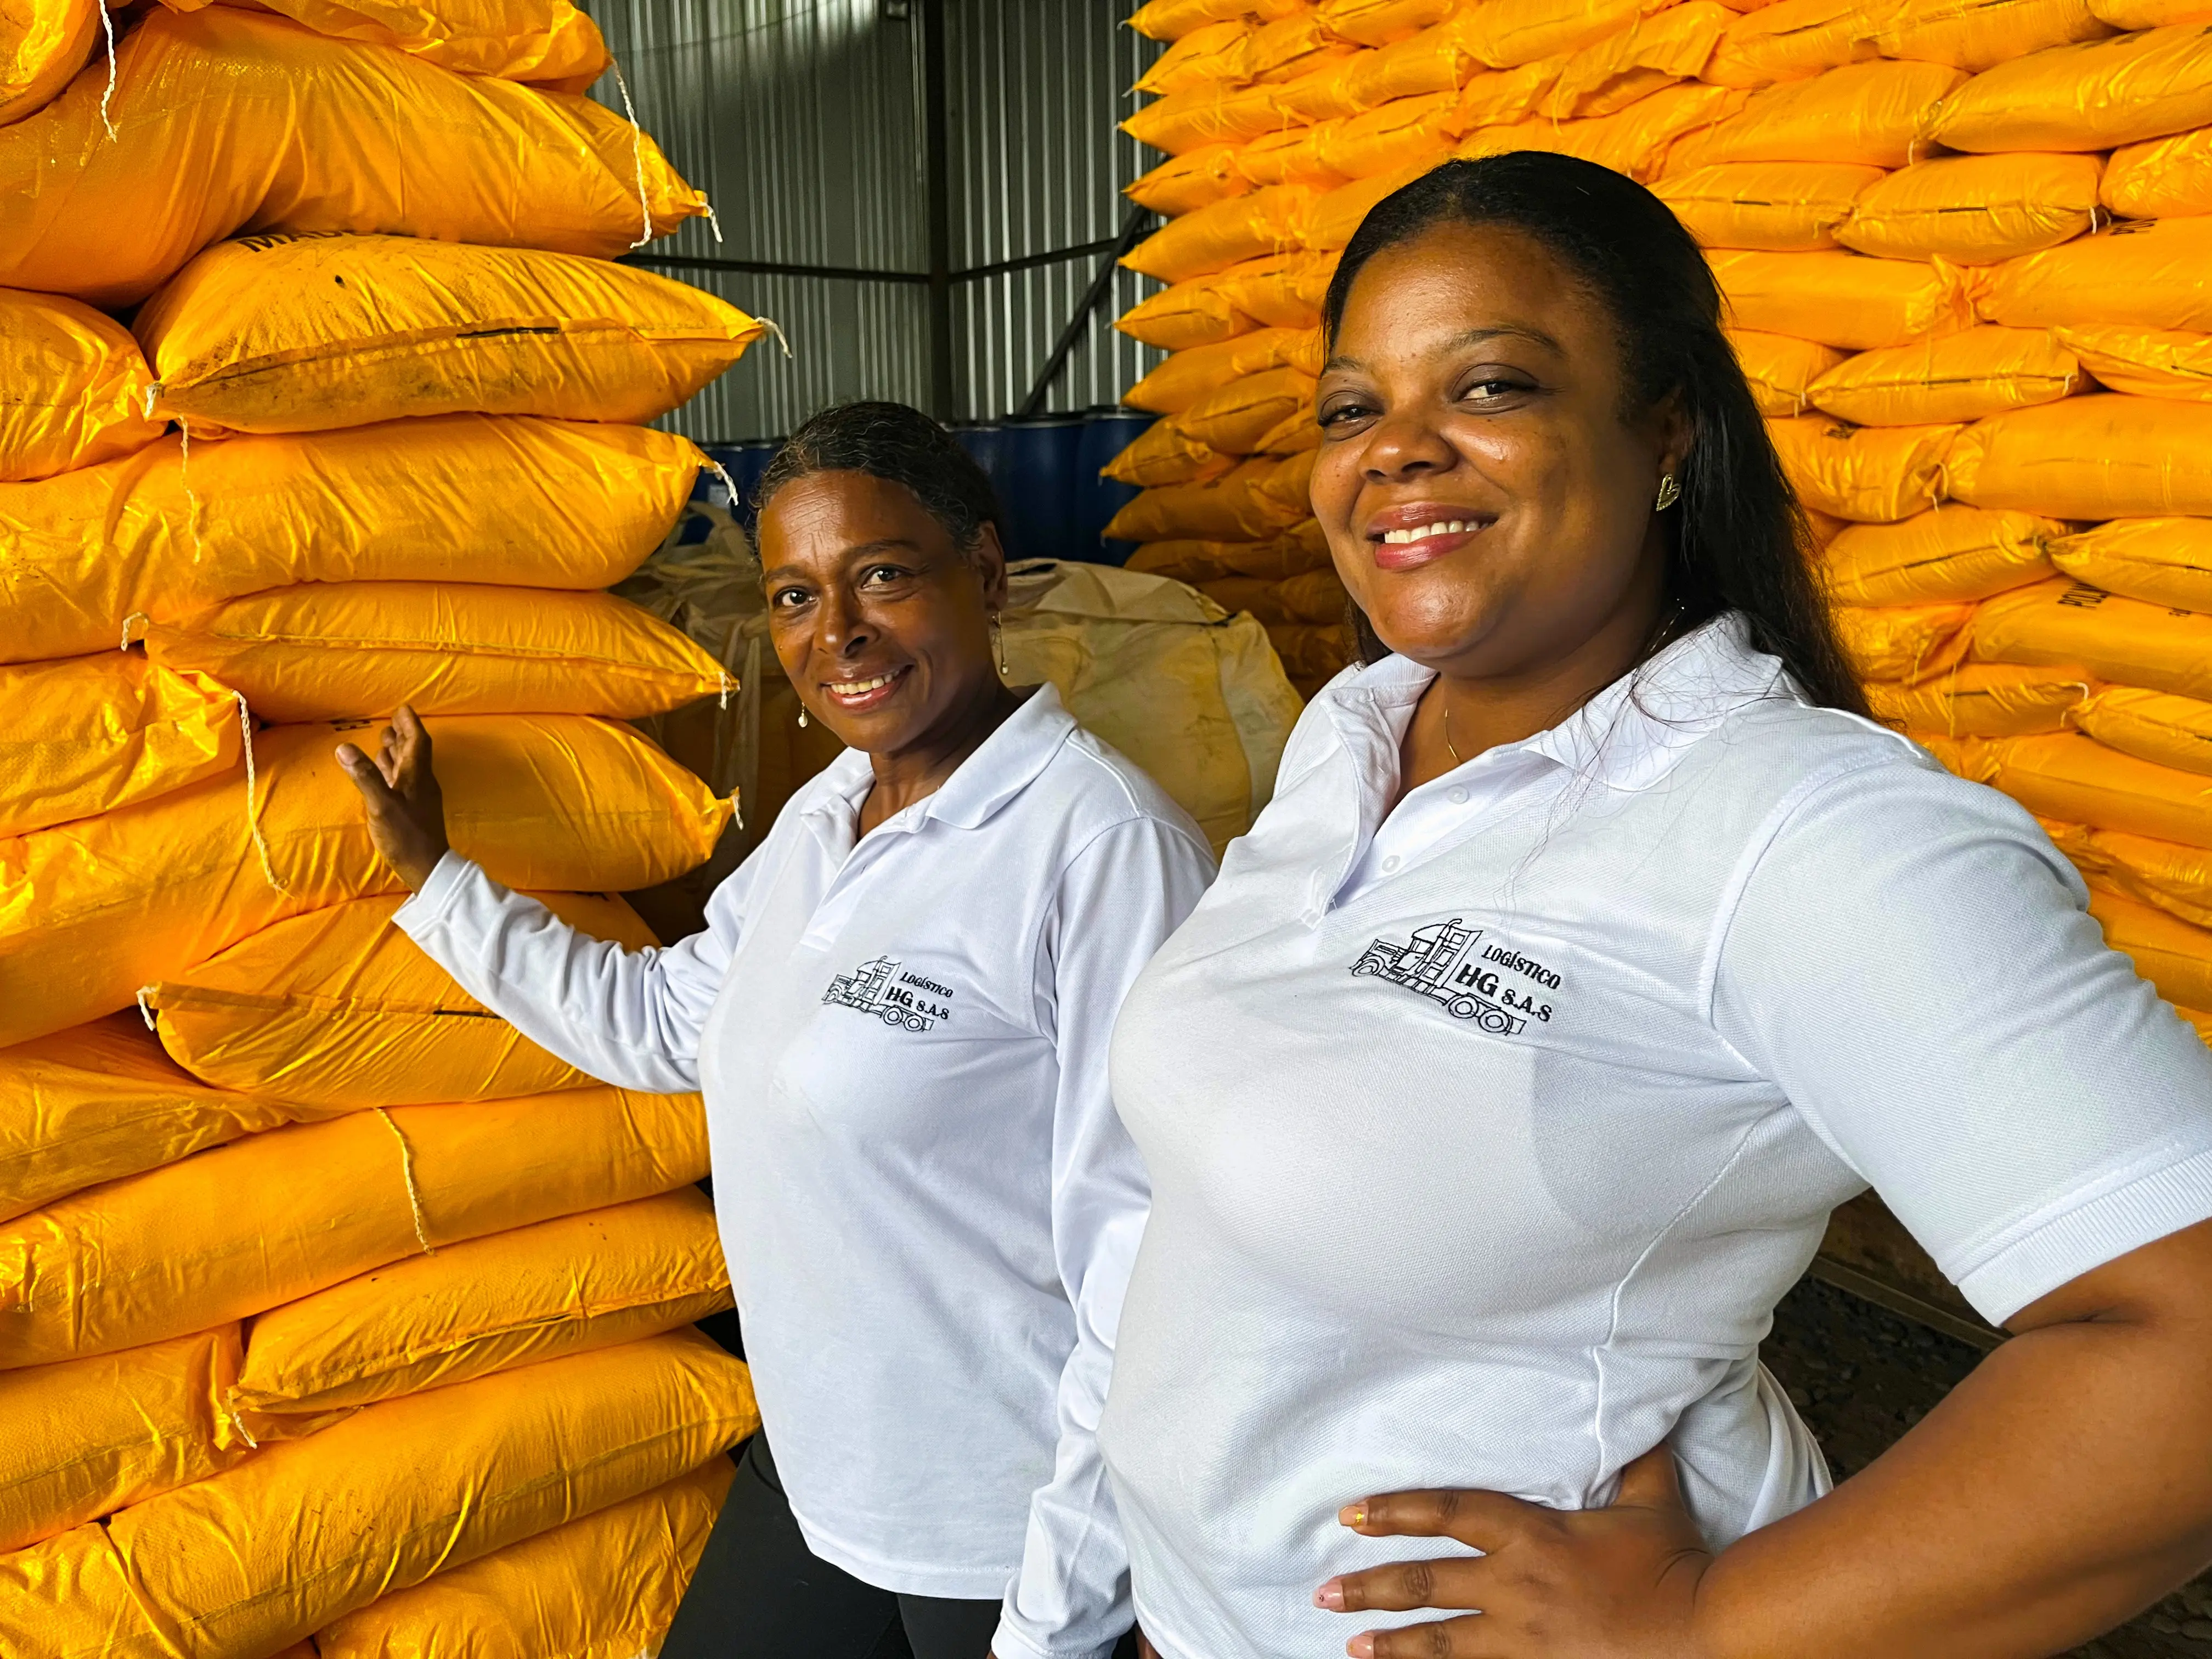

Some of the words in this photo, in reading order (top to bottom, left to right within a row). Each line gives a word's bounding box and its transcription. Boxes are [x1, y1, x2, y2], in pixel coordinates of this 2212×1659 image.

[1455, 963, 1499, 997] HG
[1481, 945, 1561, 989] LOGÍSTICO
[885, 986, 913, 1008] HG
[899, 972, 953, 997] LOGÍSTICO
